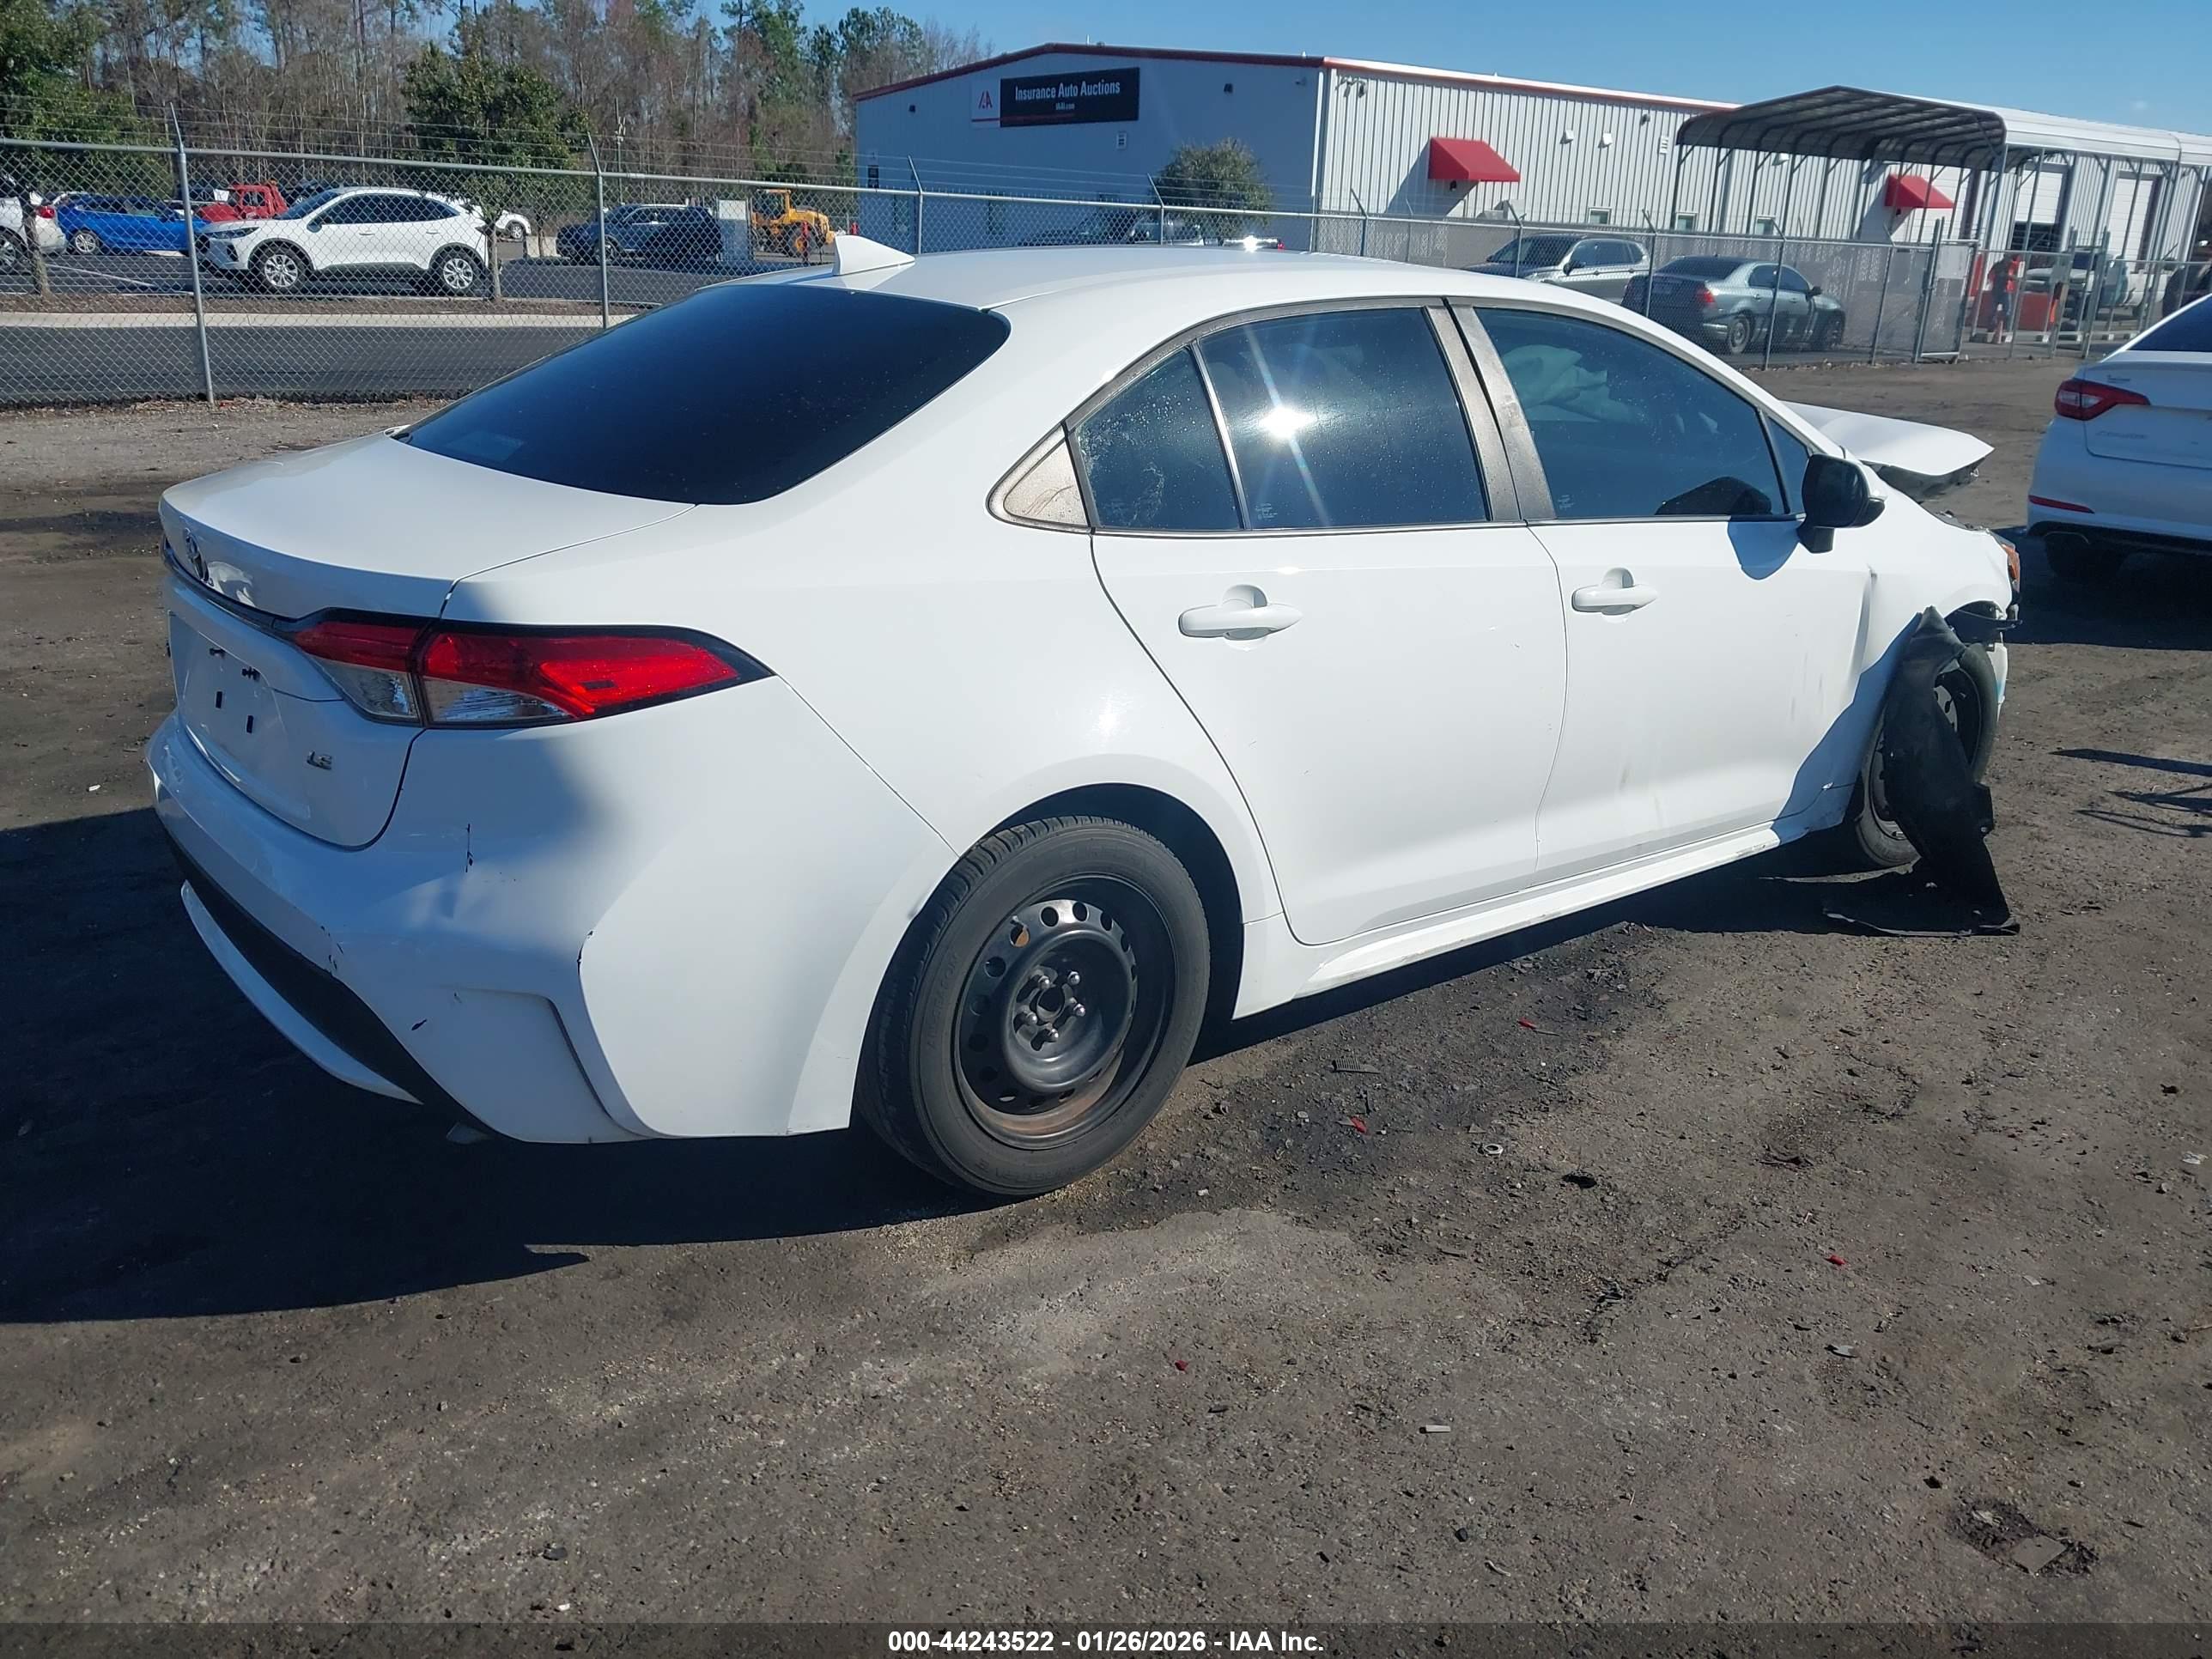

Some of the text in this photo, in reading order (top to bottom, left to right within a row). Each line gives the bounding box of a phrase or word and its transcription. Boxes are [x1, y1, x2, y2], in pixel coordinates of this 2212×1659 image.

[1015, 78, 1121, 101] Insurance Auto Auctions
